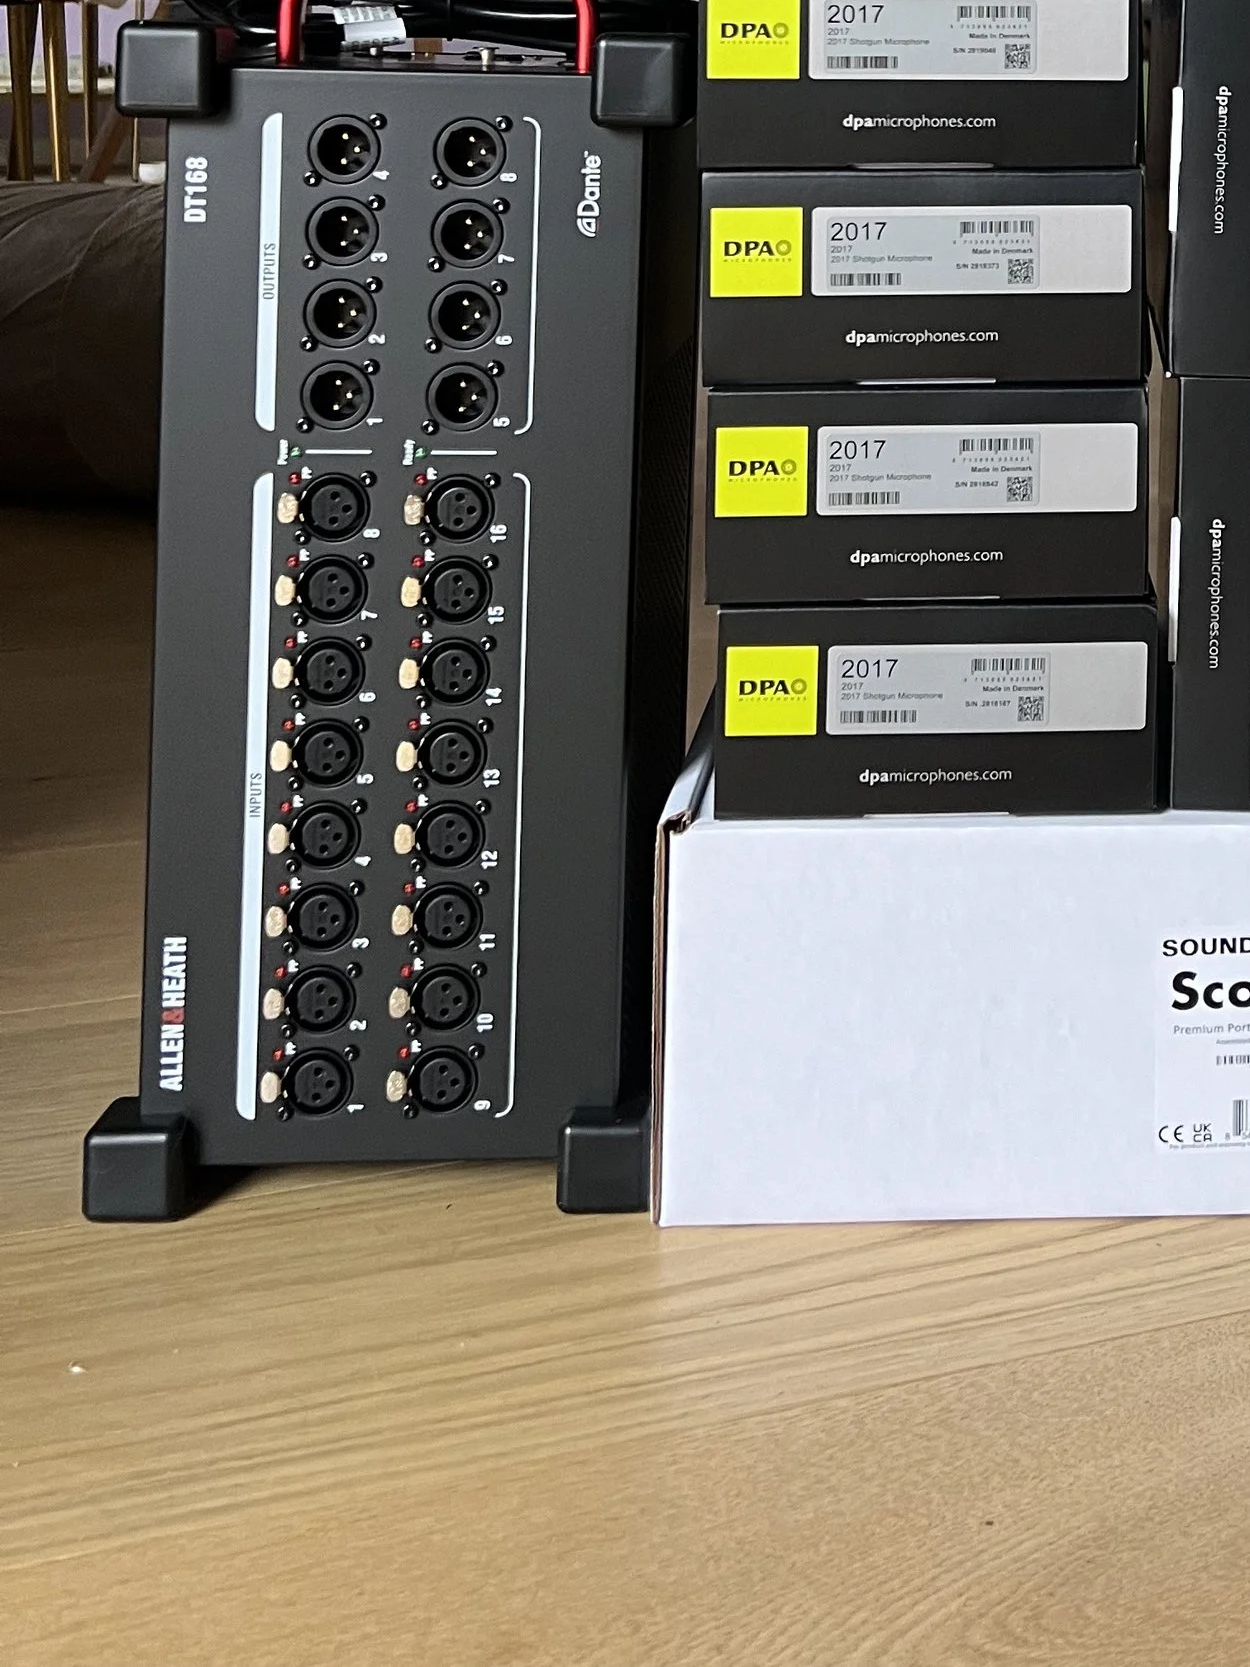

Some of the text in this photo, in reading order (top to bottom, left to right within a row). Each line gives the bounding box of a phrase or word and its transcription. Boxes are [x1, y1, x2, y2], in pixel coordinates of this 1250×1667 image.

[828, 5, 884, 23] 2017
[722, 24, 771, 38] DPA
[843, 114, 995, 130] dpamicrophones.com
[1214, 86, 1231, 233] dpamicrophones.com
[373, 170, 389, 179] 4
[500, 173, 518, 183] 8
[184, 157, 207, 222] DT168
[578, 154, 601, 218] Dante
[831, 222, 886, 241] 2017
[725, 241, 774, 256] DPA
[831, 245, 852, 254] 2017
[371, 252, 388, 262] 3
[498, 254, 514, 263] 7
[831, 254, 933, 263] 2017 Shotgun Microphone
[262, 243, 276, 300] OUTPUTS
[368, 334, 385, 344] 2
[495, 336, 512, 346] 6
[846, 330, 998, 346] dpamicrophones.com
[493, 417, 510, 428] 5
[830, 440, 886, 459] 2017
[730, 461, 779, 476] DPA
[830, 464, 851, 472] 2017
[850, 549, 1003, 566] dpamicrophones.com
[1208, 519, 1225, 668] dpamicrophones.com
[842, 659, 898, 678] 2017
[740, 680, 789, 695] DPA
[841, 682, 863, 690] 2017
[859, 769, 1011, 786] dpamicrophones.com
[249, 772, 262, 818] INPUTS
[1174, 1025, 1224, 1034] Premium
